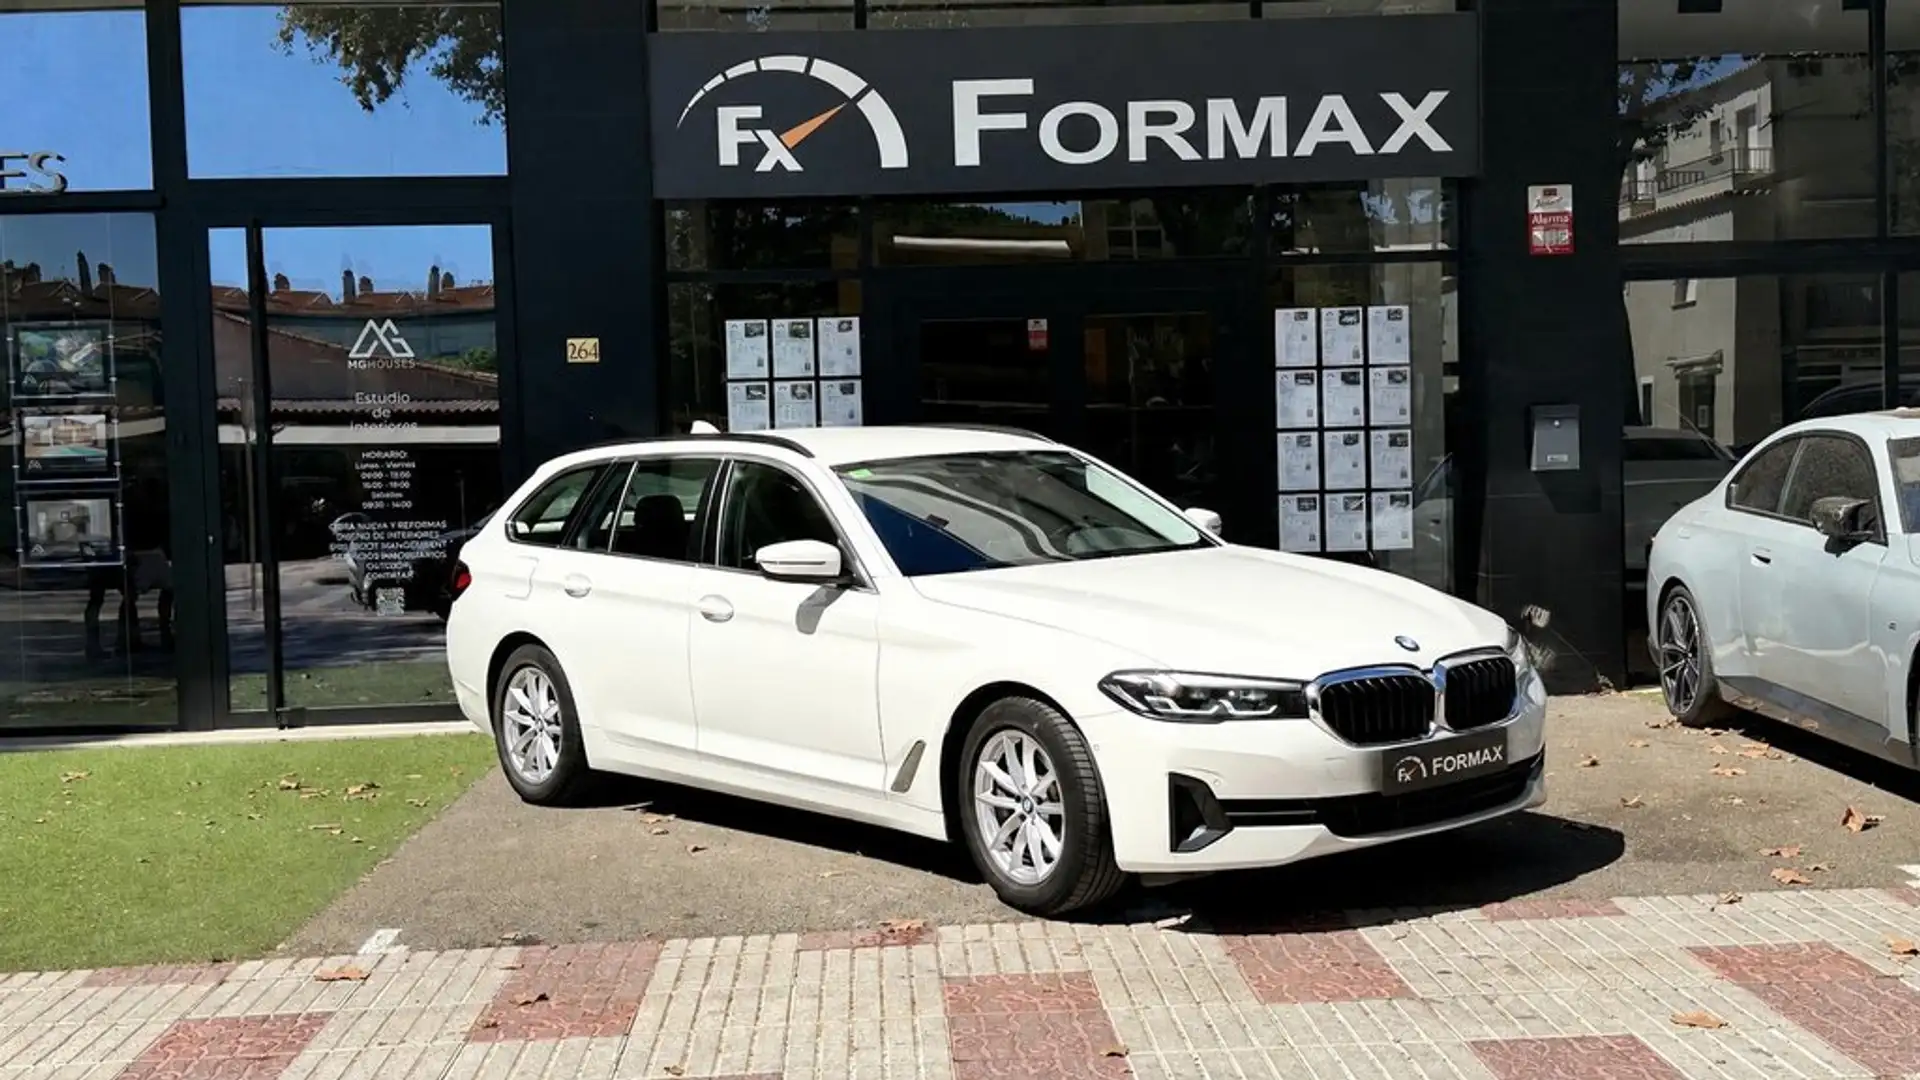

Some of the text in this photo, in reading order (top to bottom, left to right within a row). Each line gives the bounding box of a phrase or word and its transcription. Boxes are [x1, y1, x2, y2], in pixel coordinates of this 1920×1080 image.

[952, 78, 1454, 167] FORMAX
[567, 340, 598, 360] 264
[355, 392, 410, 404] Estudio
[371, 407, 391, 419] de
[1432, 744, 1504, 776] FORMAX
